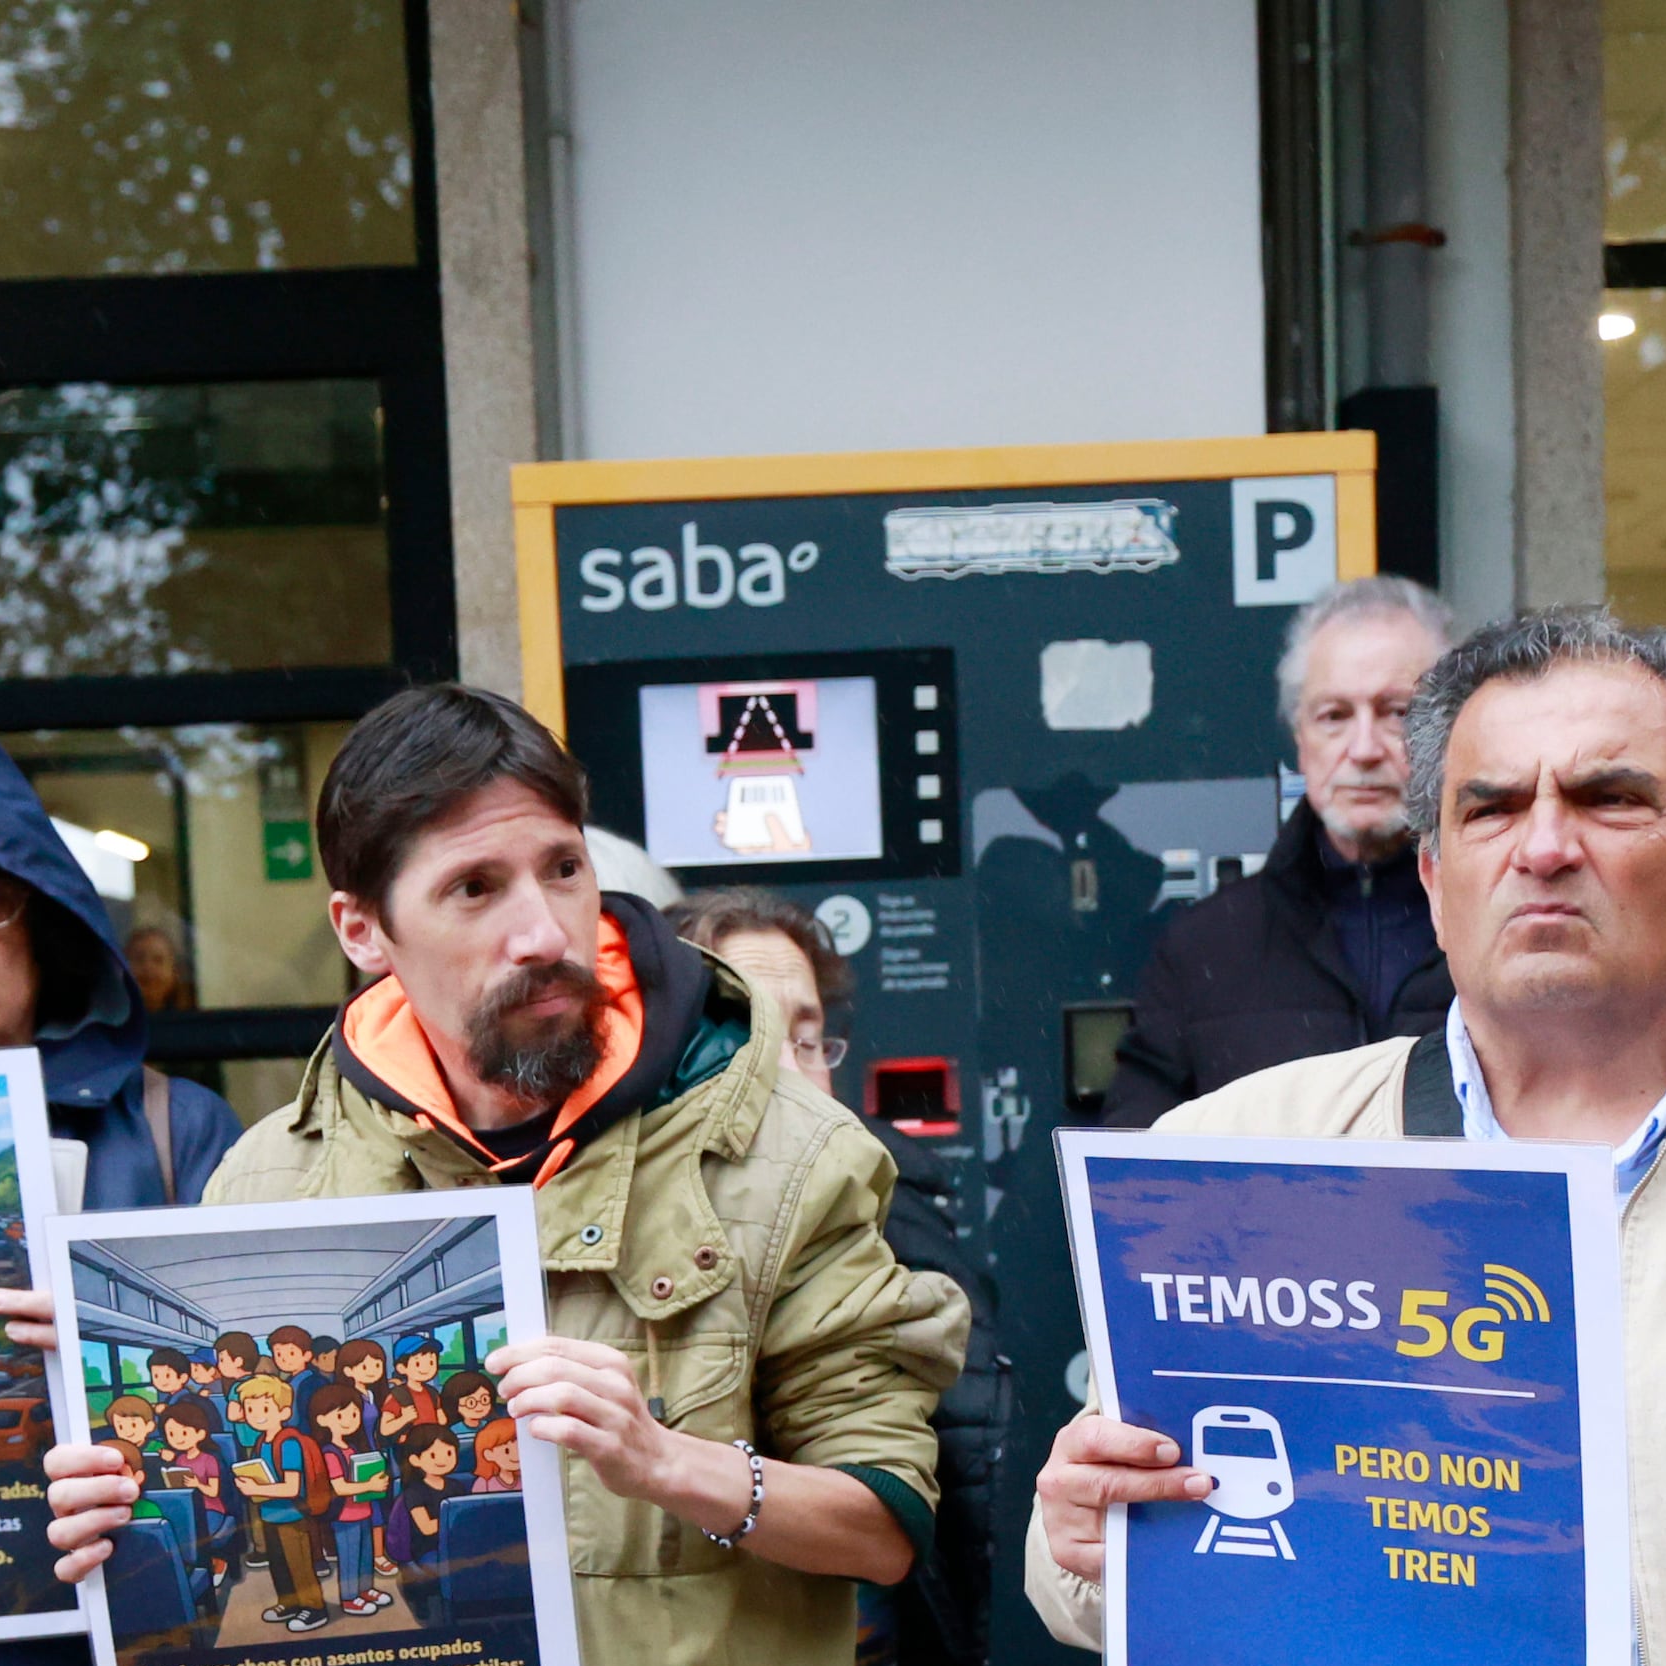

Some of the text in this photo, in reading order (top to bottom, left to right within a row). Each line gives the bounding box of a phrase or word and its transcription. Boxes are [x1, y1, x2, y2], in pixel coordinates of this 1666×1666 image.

[1254, 500, 1314, 582] P
[832, 909, 851, 939] 2
[1139, 1271, 1506, 1363] TEMOSS 5G
[1334, 1443, 1522, 1493] PERO NON
[1365, 1495, 1492, 1539] TEMOS
[1382, 1546, 1477, 1588] TREN
[398, 1638, 483, 1661] ocupados
